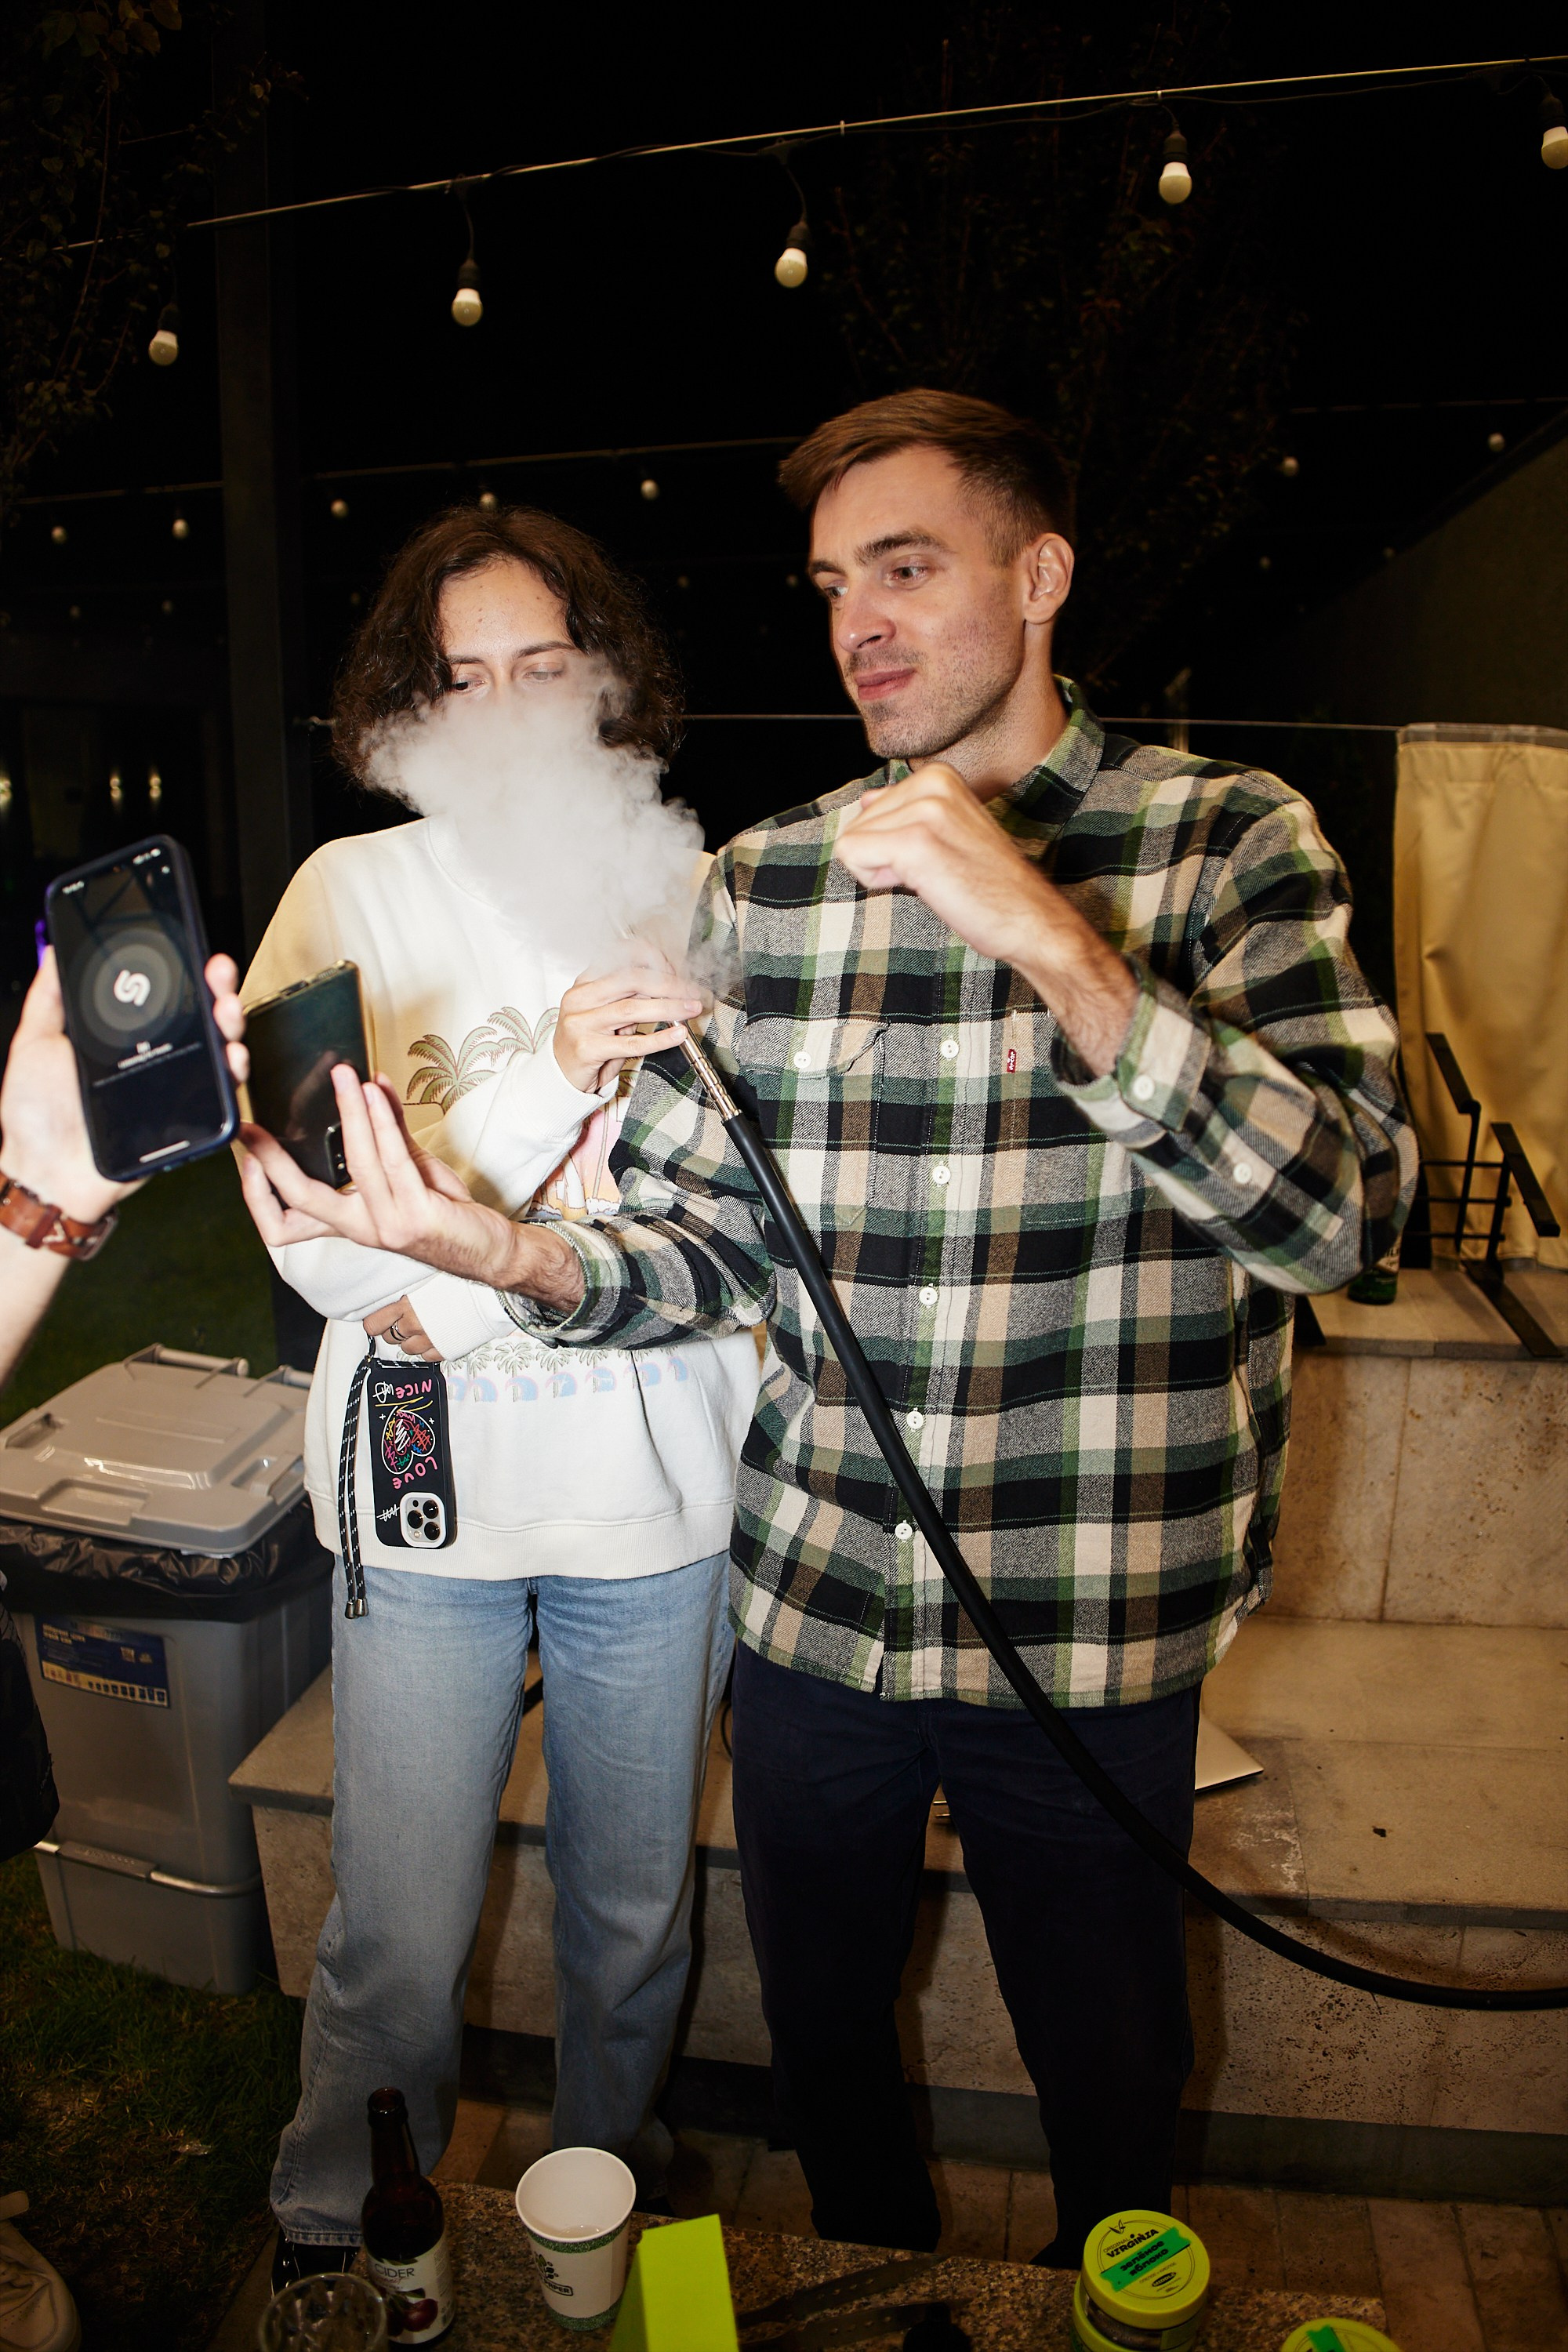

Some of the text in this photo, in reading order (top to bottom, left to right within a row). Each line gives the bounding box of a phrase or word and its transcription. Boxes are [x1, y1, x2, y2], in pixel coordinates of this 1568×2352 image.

[395, 1379, 432, 1399] NICE
[392, 1456, 437, 1489] LOVE
[1103, 2238, 1129, 2253] ORIGINAL
[1106, 2229, 1159, 2257] VIRGINIA
[375, 2264, 415, 2278] CIDER
[1129, 2249, 1168, 2276] яблоко
